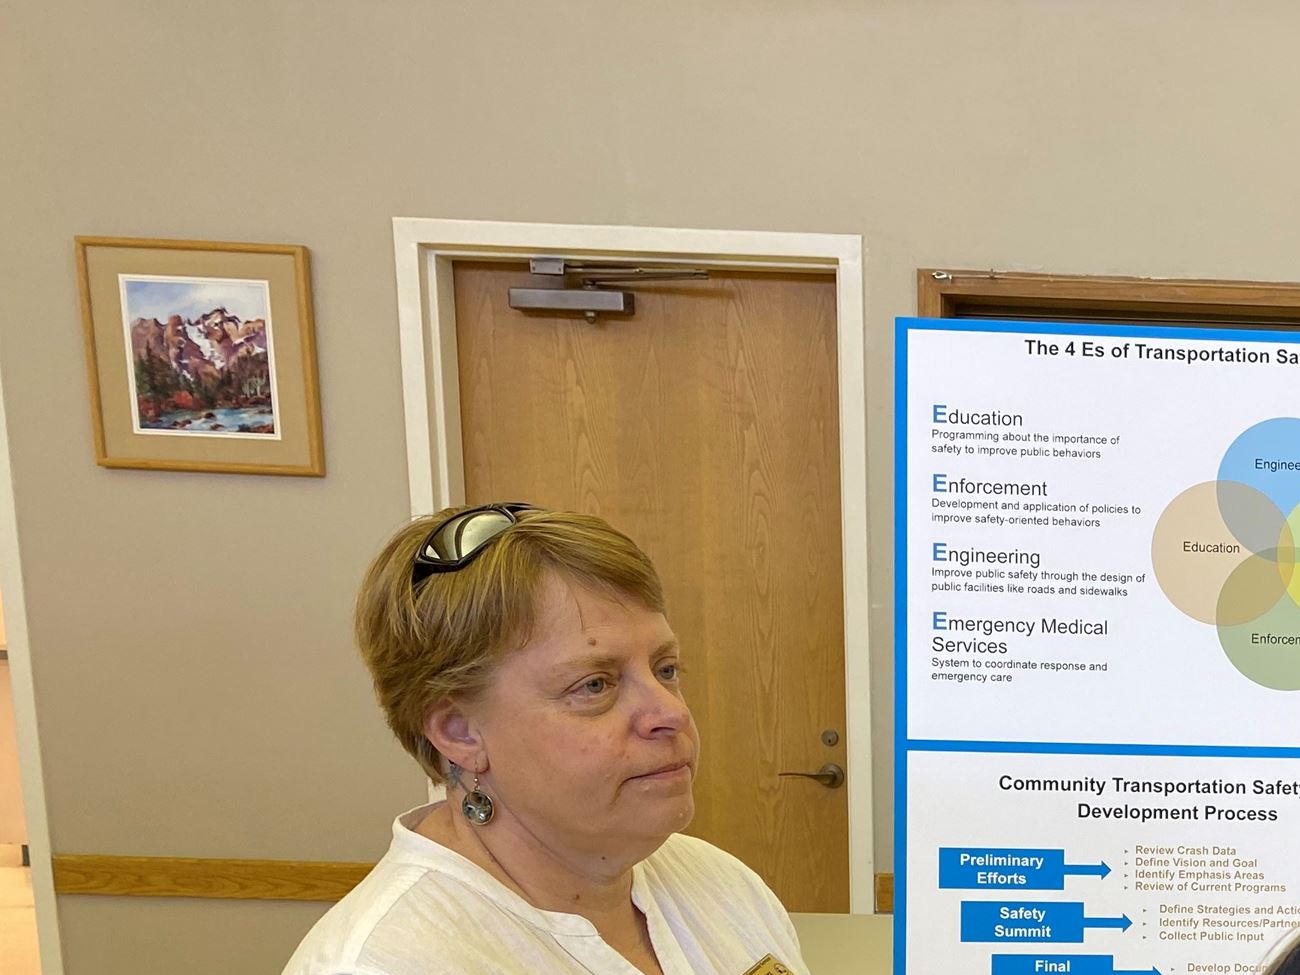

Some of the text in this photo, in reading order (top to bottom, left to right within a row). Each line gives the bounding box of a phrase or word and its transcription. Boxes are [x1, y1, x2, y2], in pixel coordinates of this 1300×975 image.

[1024, 339, 1059, 357] The
[1064, 340, 1075, 357] 4
[1081, 341, 1105, 358] Es
[1111, 342, 1129, 359] of
[1134, 343, 1270, 364] Transportation
[932, 404, 1023, 426] Education
[931, 429, 1120, 445] Programming about the importance of
[931, 444, 1101, 459] safety to improve public behaviors
[932, 473, 1048, 496] Enforcement
[931, 498, 1141, 514] Development and application of policies to
[931, 513, 1100, 527] improve safety-oriented behaviors
[932, 542, 1040, 568] Engineering
[1182, 540, 1241, 555] Education
[931, 567, 1145, 583] Improve public safety through the design of
[931, 581, 1128, 596] public facilities like roads and sidewalks
[932, 611, 1108, 637] Emergency Medical
[932, 636, 1008, 654] Services
[931, 657, 1108, 672] System to coordinate response and
[931, 672, 1012, 683] emergency care
[998, 774, 1106, 796] Community
[1112, 777, 1246, 798] Transportation
[1077, 803, 1278, 824] Development Process
[1135, 845, 1237, 857] Review Crash Data
[959, 852, 1044, 870] Preliminary
[1135, 857, 1258, 868] Define Vision and Goal
[976, 870, 1027, 886] Efforts
[1135, 869, 1265, 882] Identify Emphasis Areas
[1135, 882, 1286, 895] Review of Current Programs
[999, 905, 1046, 924] Safety
[1159, 904, 1194, 914] Define
[1196, 904, 1250, 917] Strategies
[1254, 905, 1274, 914] and
[1159, 918, 1199, 929] Identify
[994, 924, 1052, 940] Summit
[1159, 931, 1264, 942] Collect Public Input
[1034, 958, 1071, 974] Final
[1187, 963, 1230, 973] Develop
